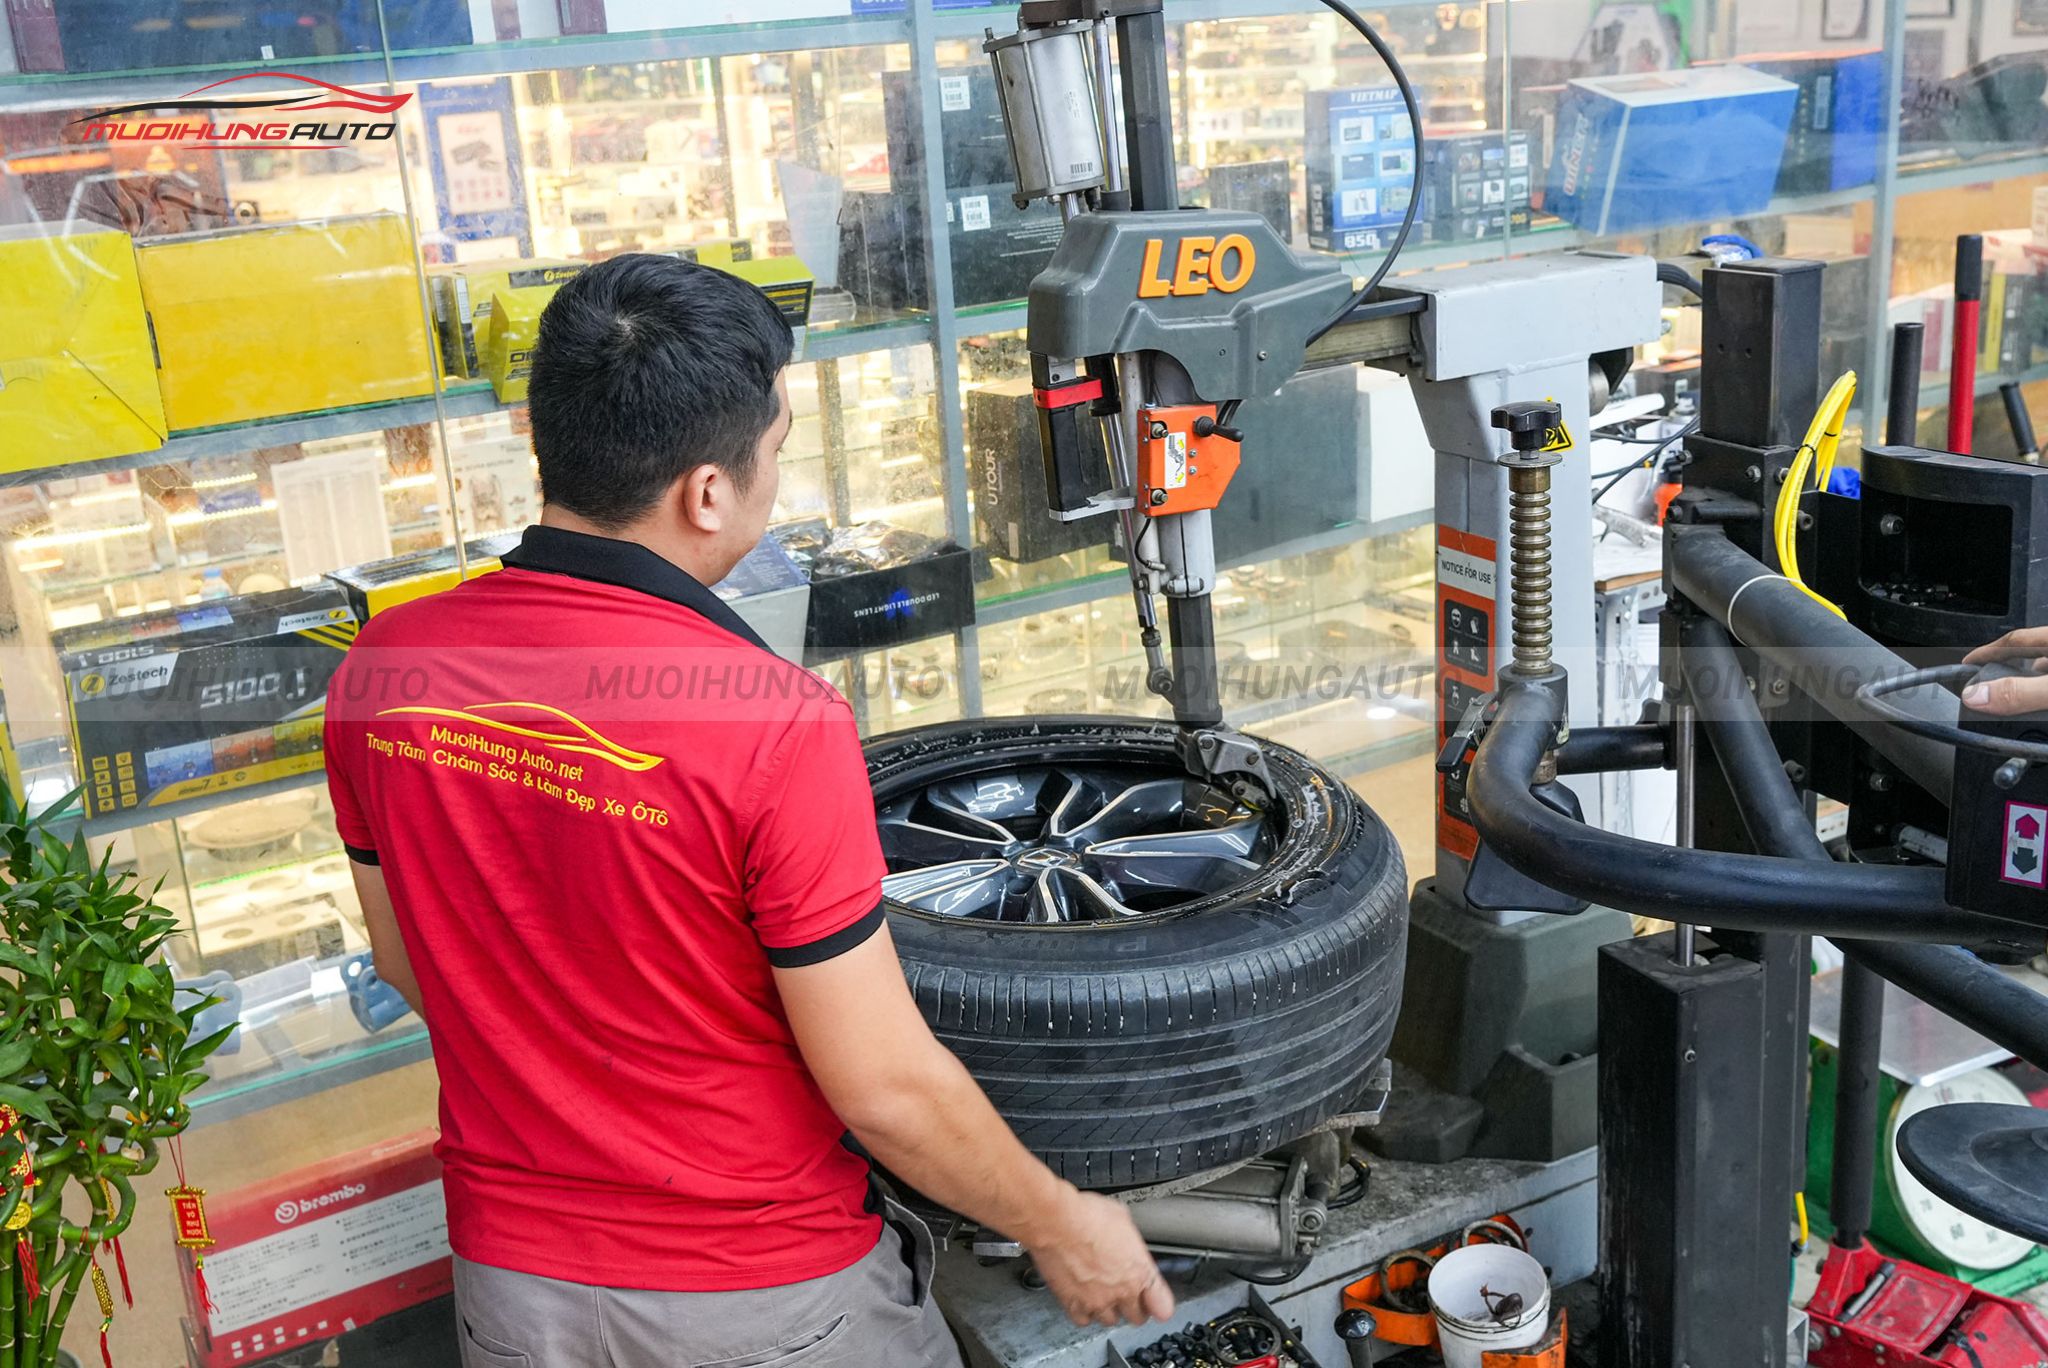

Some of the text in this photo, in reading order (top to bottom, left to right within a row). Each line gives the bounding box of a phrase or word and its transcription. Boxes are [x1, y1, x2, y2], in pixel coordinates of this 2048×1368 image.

[1138, 233, 1256, 298] LEO
[985, 448, 998, 505] UTOUR
[1441, 559, 1492, 585] NOTICE FOR USE
[108, 665, 168, 687] Zestech
[430, 724, 517, 765] MuoiHung
[366, 733, 394, 757] Trung
[396, 740, 427, 762] Tâm
[432, 748, 484, 775] Chăm
[488, 762, 518, 784] Sóc
[523, 771, 535, 787] &
[537, 775, 563, 801] Làm
[565, 788, 596, 812] Đẹp
[601, 798, 626, 817] Xe
[299, 1183, 367, 1214] brembo
